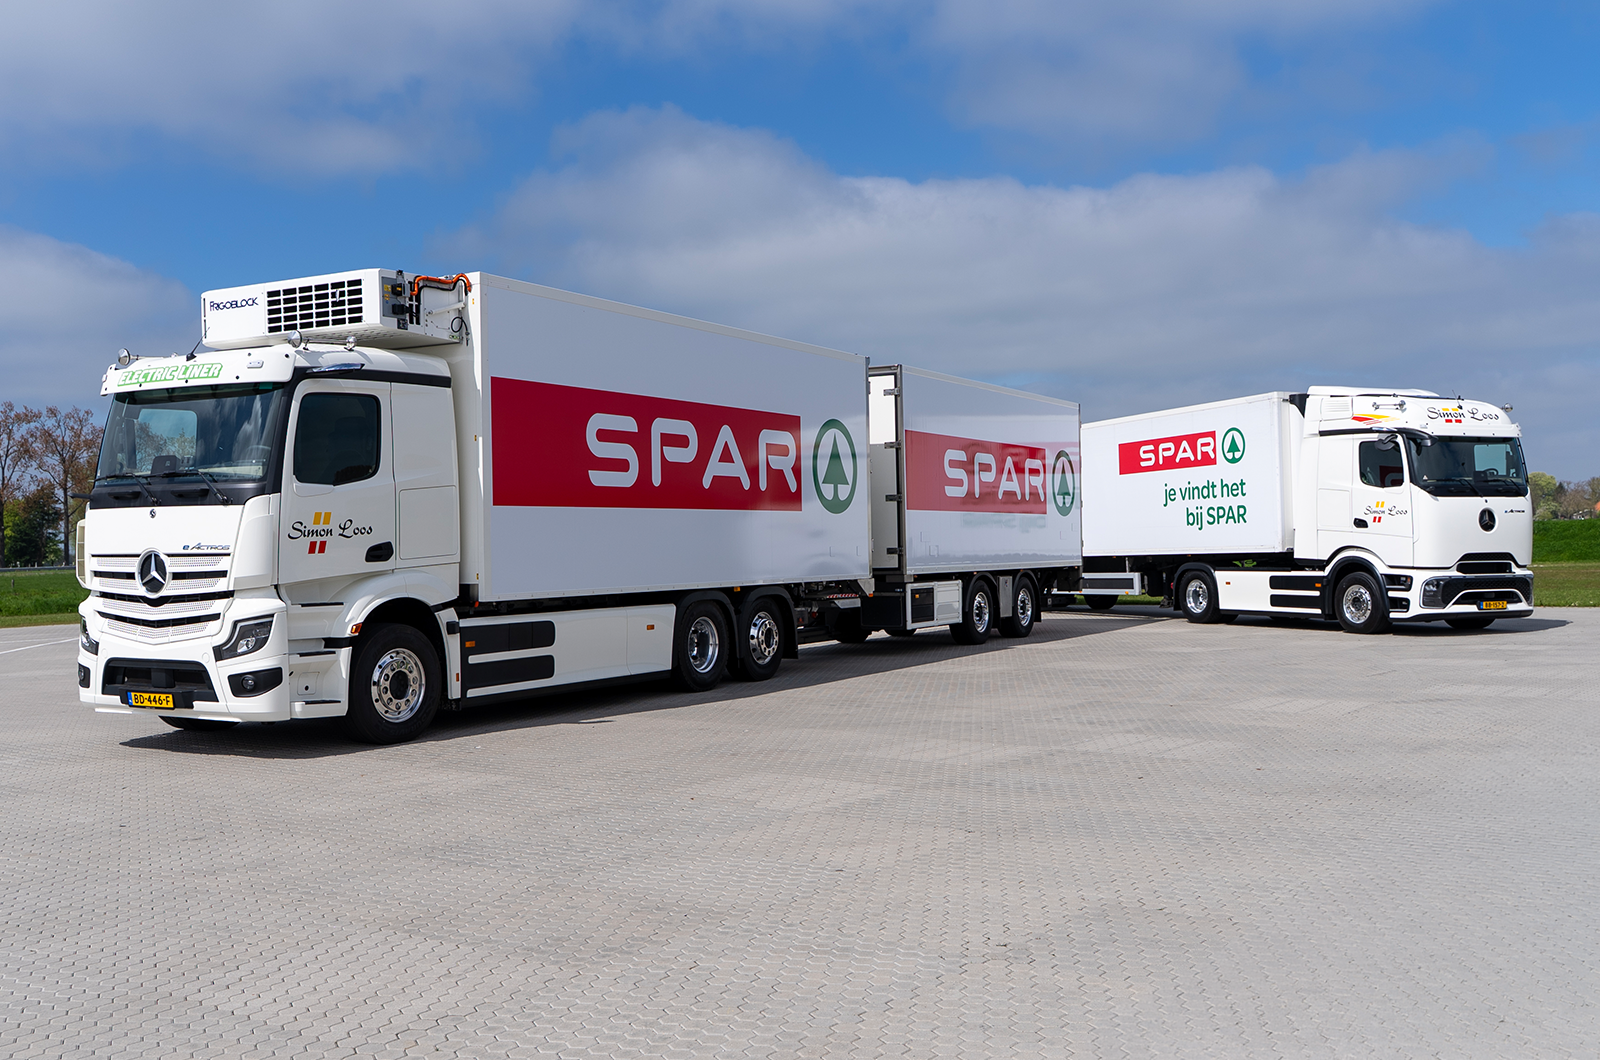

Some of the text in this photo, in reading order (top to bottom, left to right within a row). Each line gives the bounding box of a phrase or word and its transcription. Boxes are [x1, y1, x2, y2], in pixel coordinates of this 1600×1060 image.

[118, 363, 222, 386] ELECTRIC LINER
[1427, 406, 1499, 421] Simon Loos
[585, 412, 798, 493] SPAR
[1139, 436, 1215, 467] SPAR
[943, 448, 1045, 502] SPAR
[1163, 478, 1246, 507] je vindt het
[287, 518, 373, 540] Simon Loos
[1186, 504, 1247, 531] bij SPAR
[133, 694, 171, 706] BD-446-F
